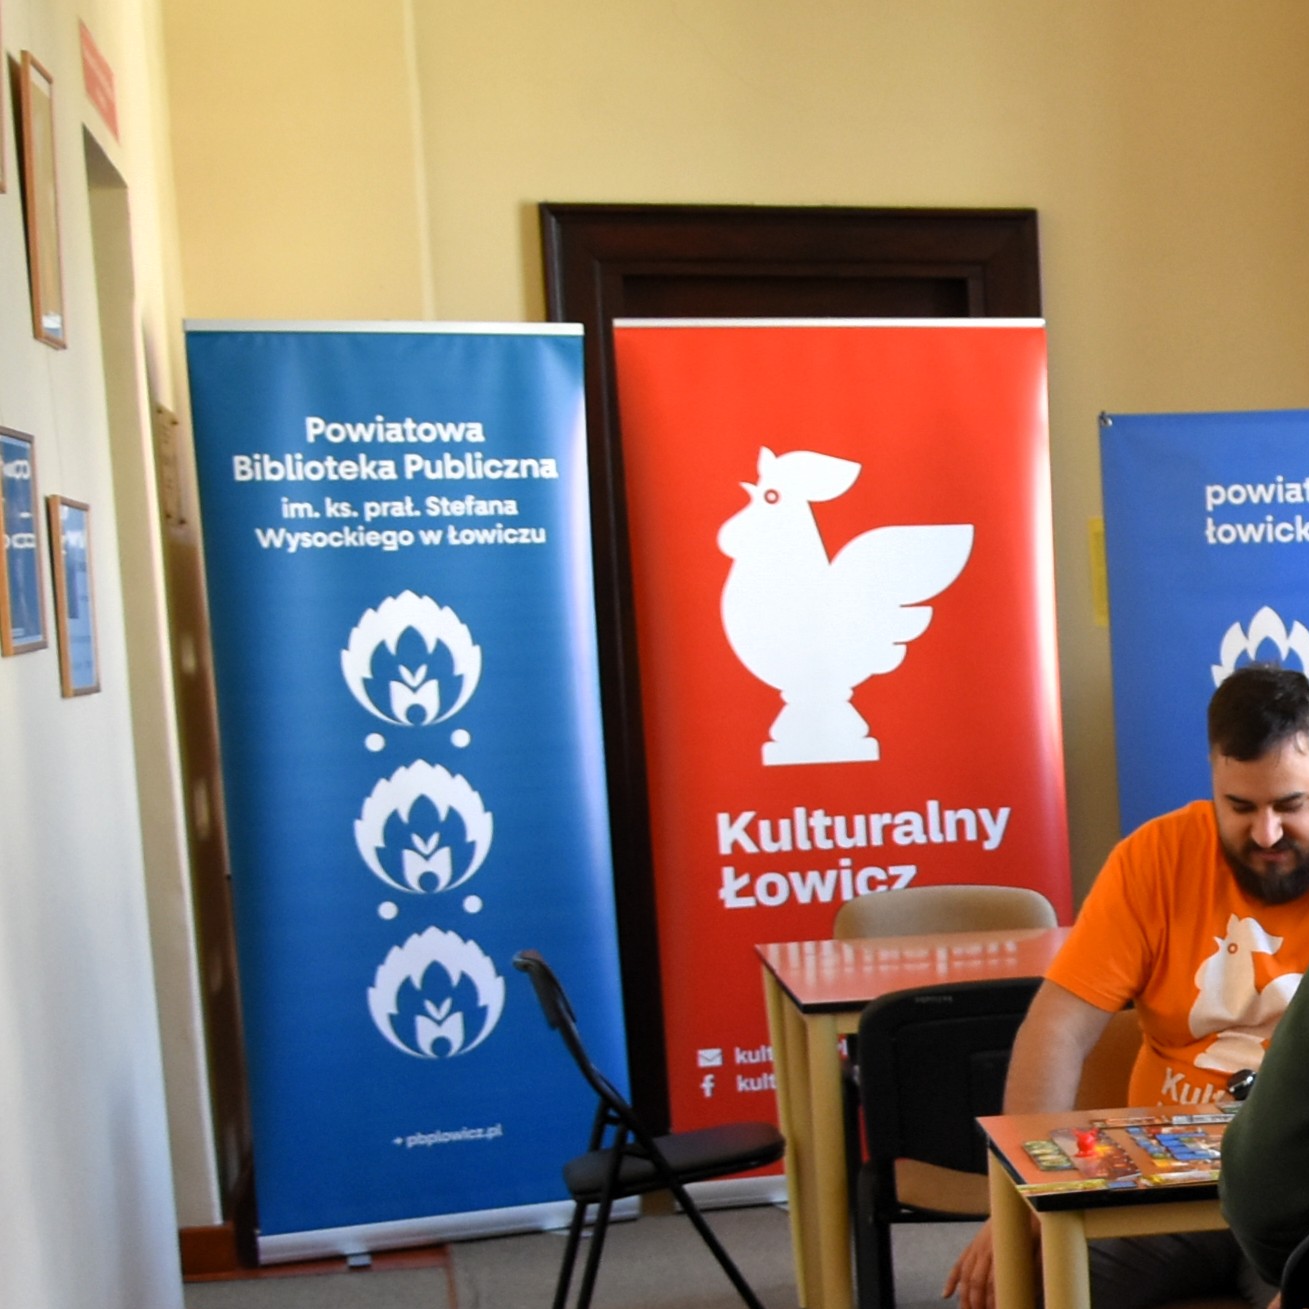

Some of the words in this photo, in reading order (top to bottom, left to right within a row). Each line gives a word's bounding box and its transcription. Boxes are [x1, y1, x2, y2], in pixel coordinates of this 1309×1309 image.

[305, 414, 486, 443] Powiatowa
[232, 453, 398, 482] Biblioteka
[404, 451, 558, 480] Publiczna
[281, 497, 320, 519] im.
[324, 497, 358, 518] ks.
[364, 495, 421, 522] prał.
[425, 494, 519, 517] Stefana
[254, 525, 415, 553] Wysockiego
[418, 527, 443, 546] w
[447, 522, 547, 546] Łowiczu
[716, 799, 1011, 856] Kulturalny
[718, 857, 918, 909] Łowicz
[1162, 1066, 1215, 1105] Kul
